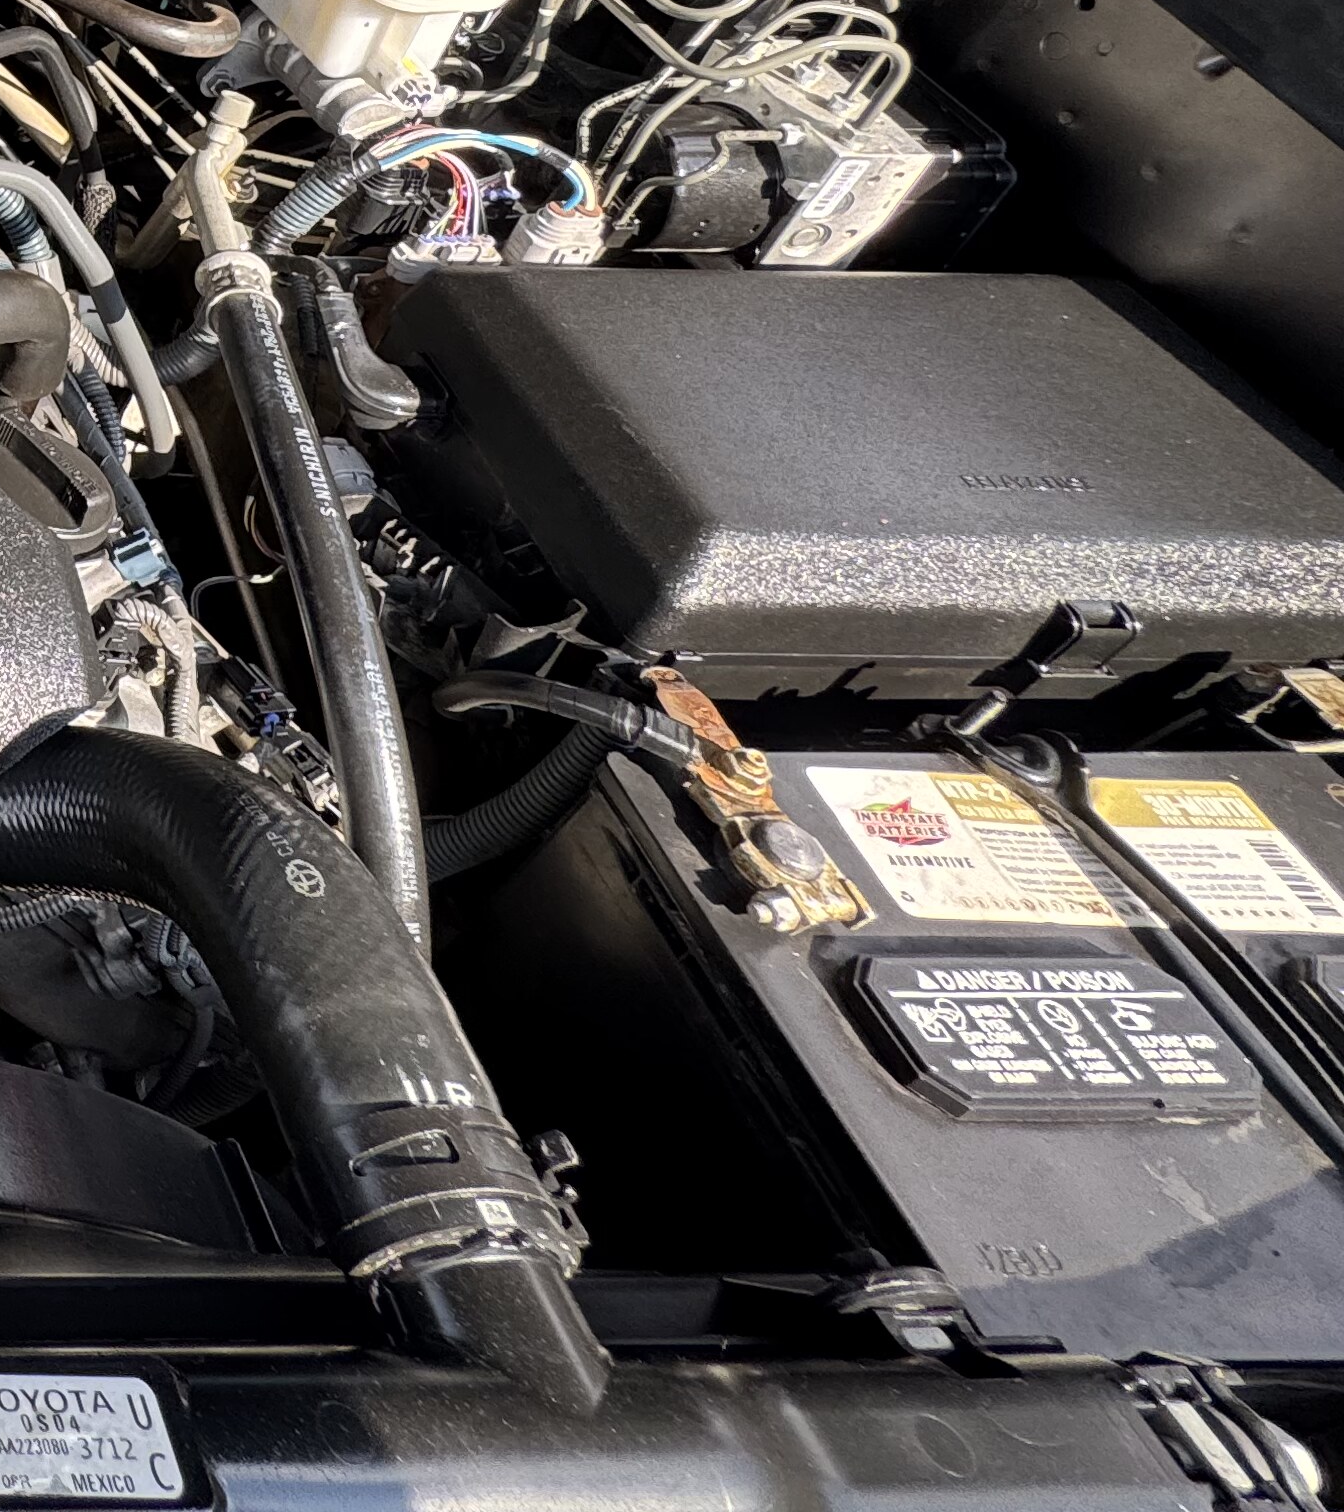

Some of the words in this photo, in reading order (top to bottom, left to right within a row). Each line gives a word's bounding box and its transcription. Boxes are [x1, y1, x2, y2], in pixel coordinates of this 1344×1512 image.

[854, 809, 948, 825] INTERSTATE
[866, 823, 951, 838] BATTERIES
[887, 853, 976, 869] AUTOMOTIVE
[933, 969, 1032, 991] DANGER
[1044, 969, 1135, 992] POISON
[126, 1393, 154, 1431] U
[148, 1451, 176, 1492] C
[70, 1473, 137, 1494] MEXICO
